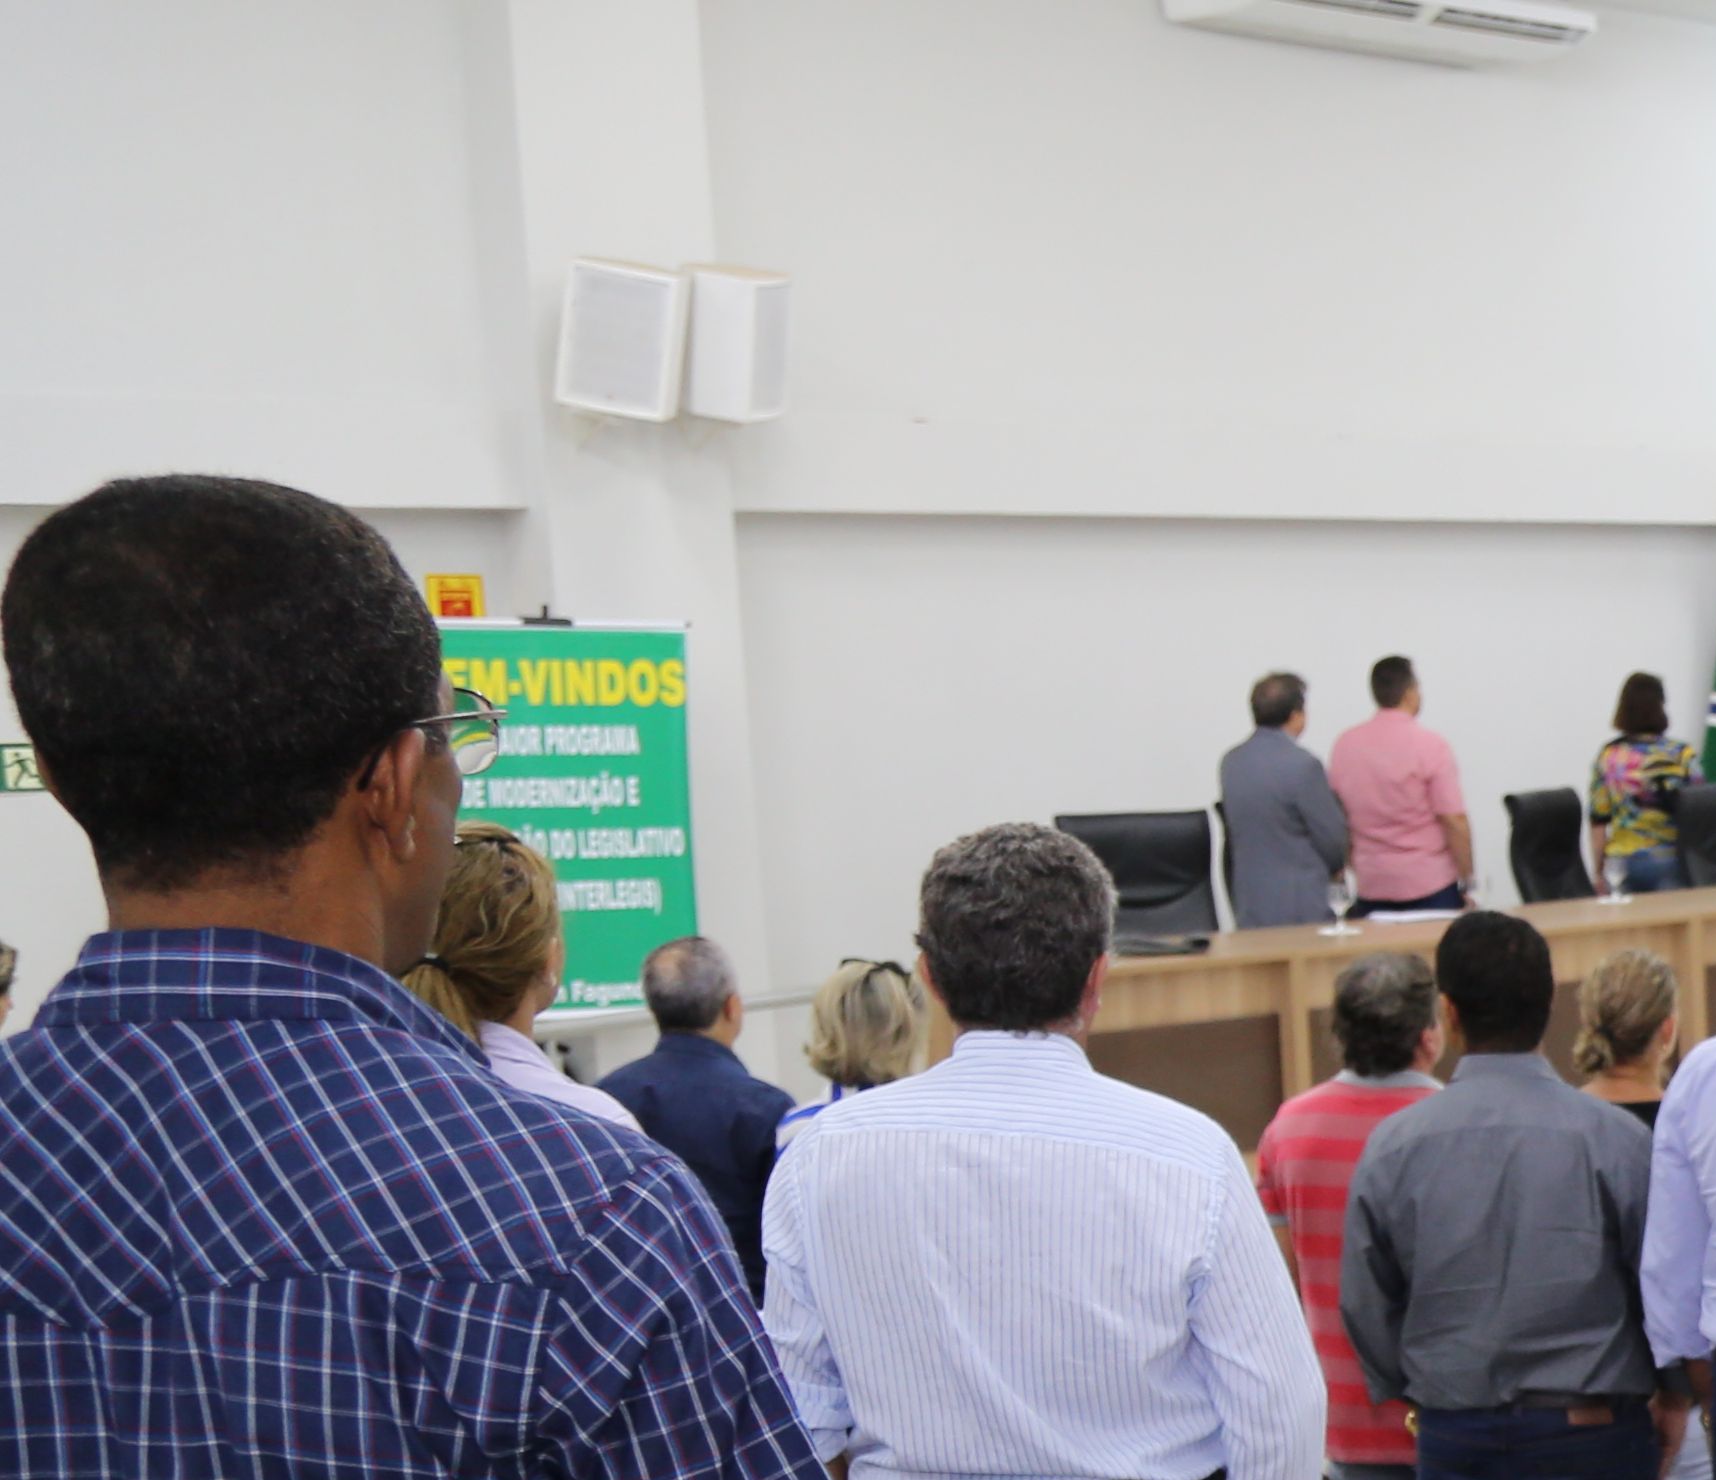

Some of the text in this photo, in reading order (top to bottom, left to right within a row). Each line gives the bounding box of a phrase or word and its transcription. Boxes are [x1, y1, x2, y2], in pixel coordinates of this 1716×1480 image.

[443, 657, 686, 708] EM-VINDOS
[497, 724, 641, 757] AIOR PROGRAMA
[462, 770, 641, 816] DE MODERNIZAÇÃO E
[549, 828, 576, 860] DO
[577, 826, 685, 859] LEGISLATIVO
[556, 877, 662, 916] INTERLEGIS)
